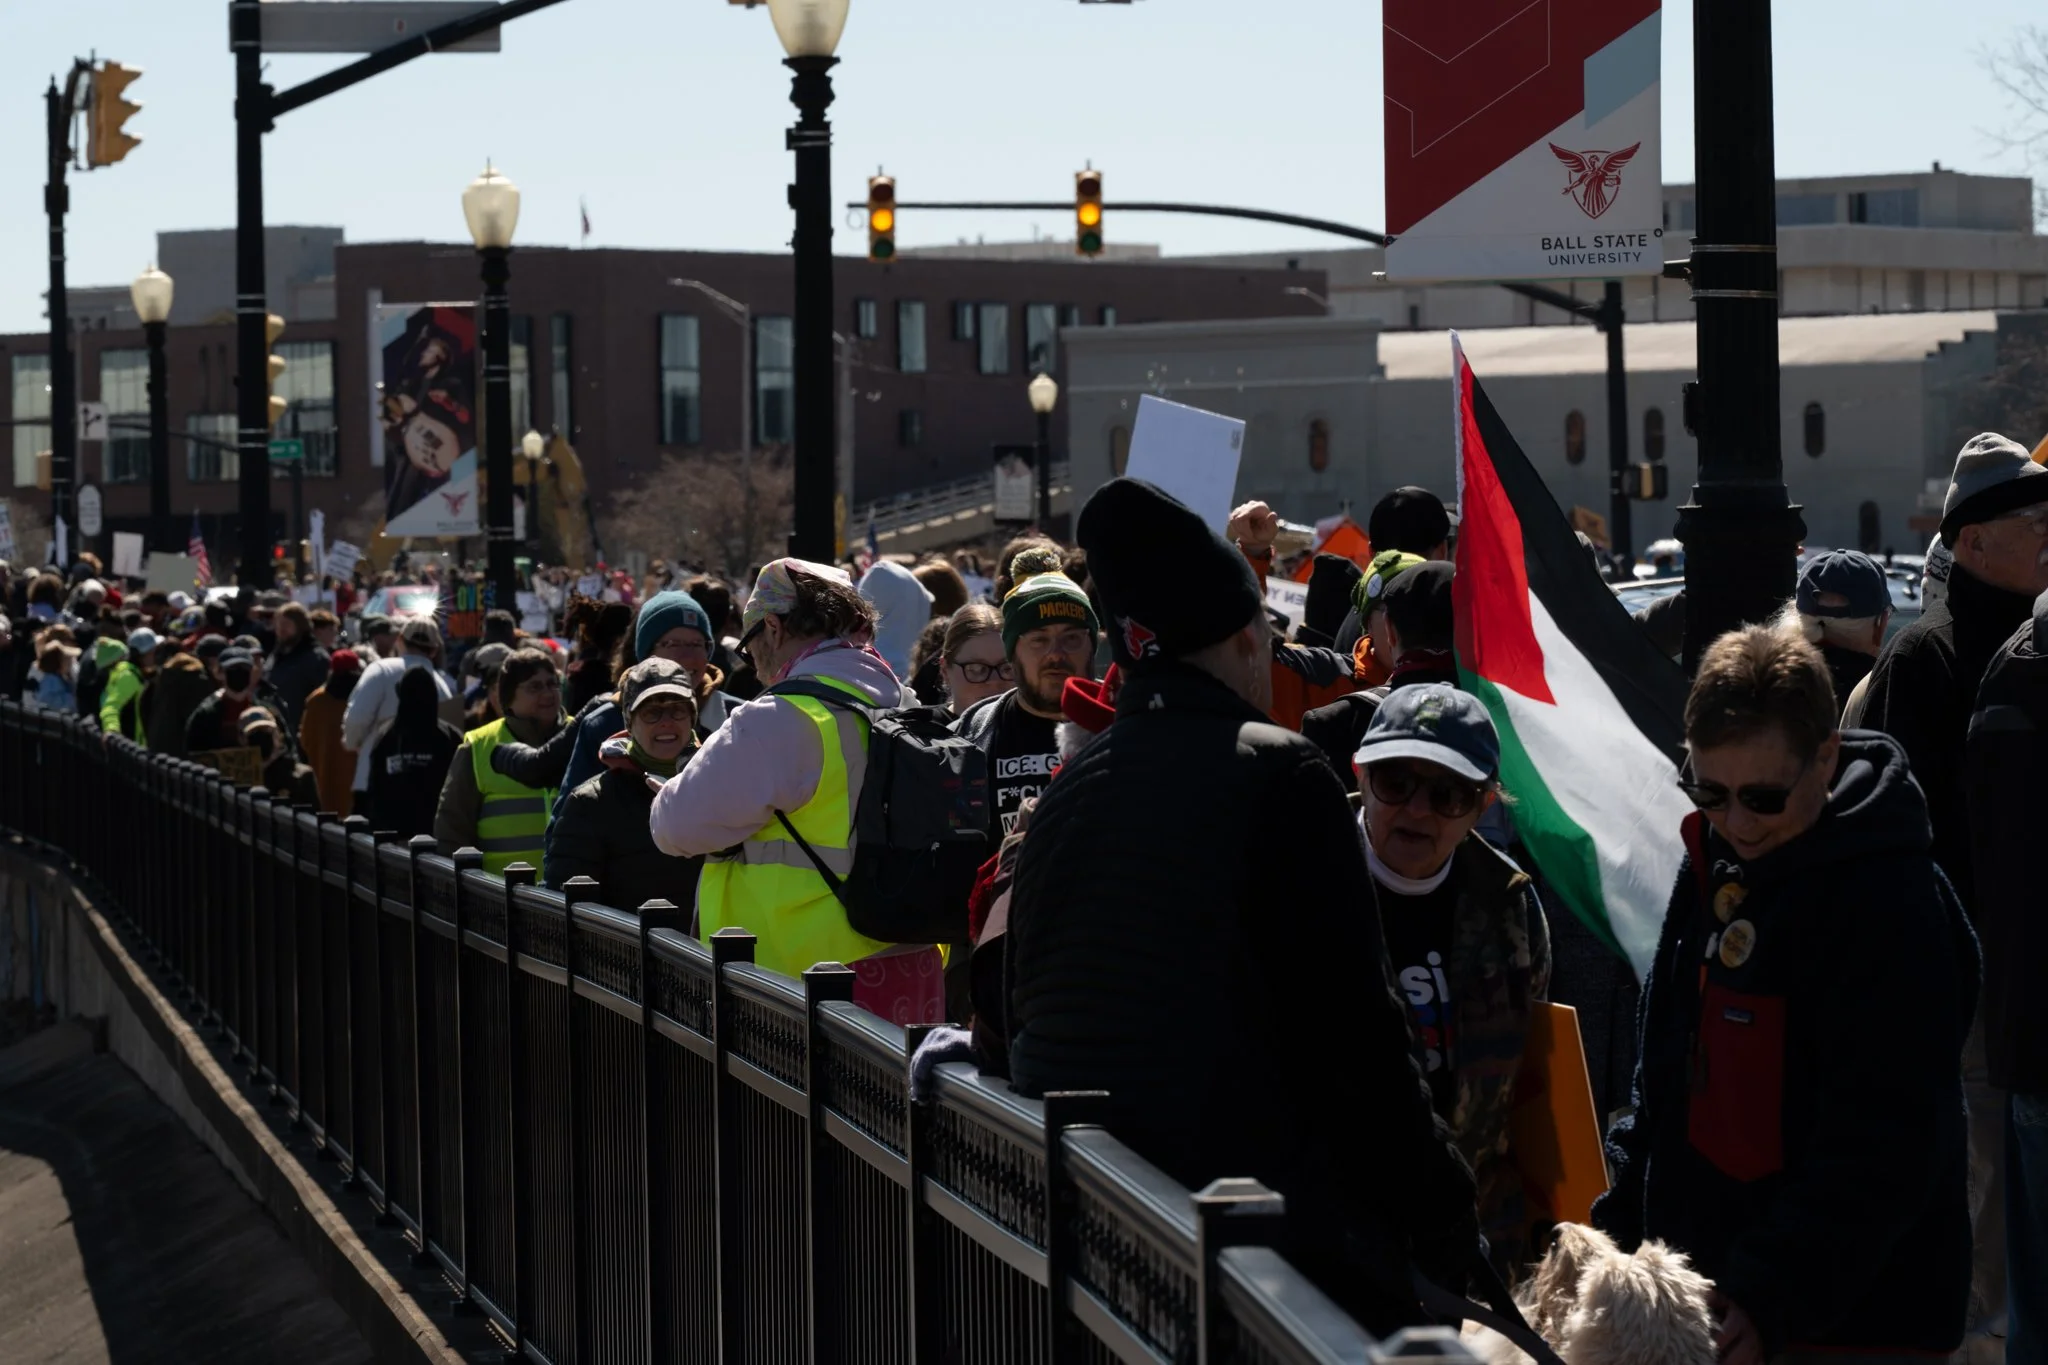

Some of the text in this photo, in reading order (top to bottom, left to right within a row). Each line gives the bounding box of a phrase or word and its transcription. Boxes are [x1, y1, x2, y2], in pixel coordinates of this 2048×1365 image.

[1541, 233, 1648, 251] BALL STATE
[1548, 251, 1642, 266] UNIVERSITY
[1038, 601, 1086, 620] PACKERS
[999, 757, 1038, 776] ICE:
